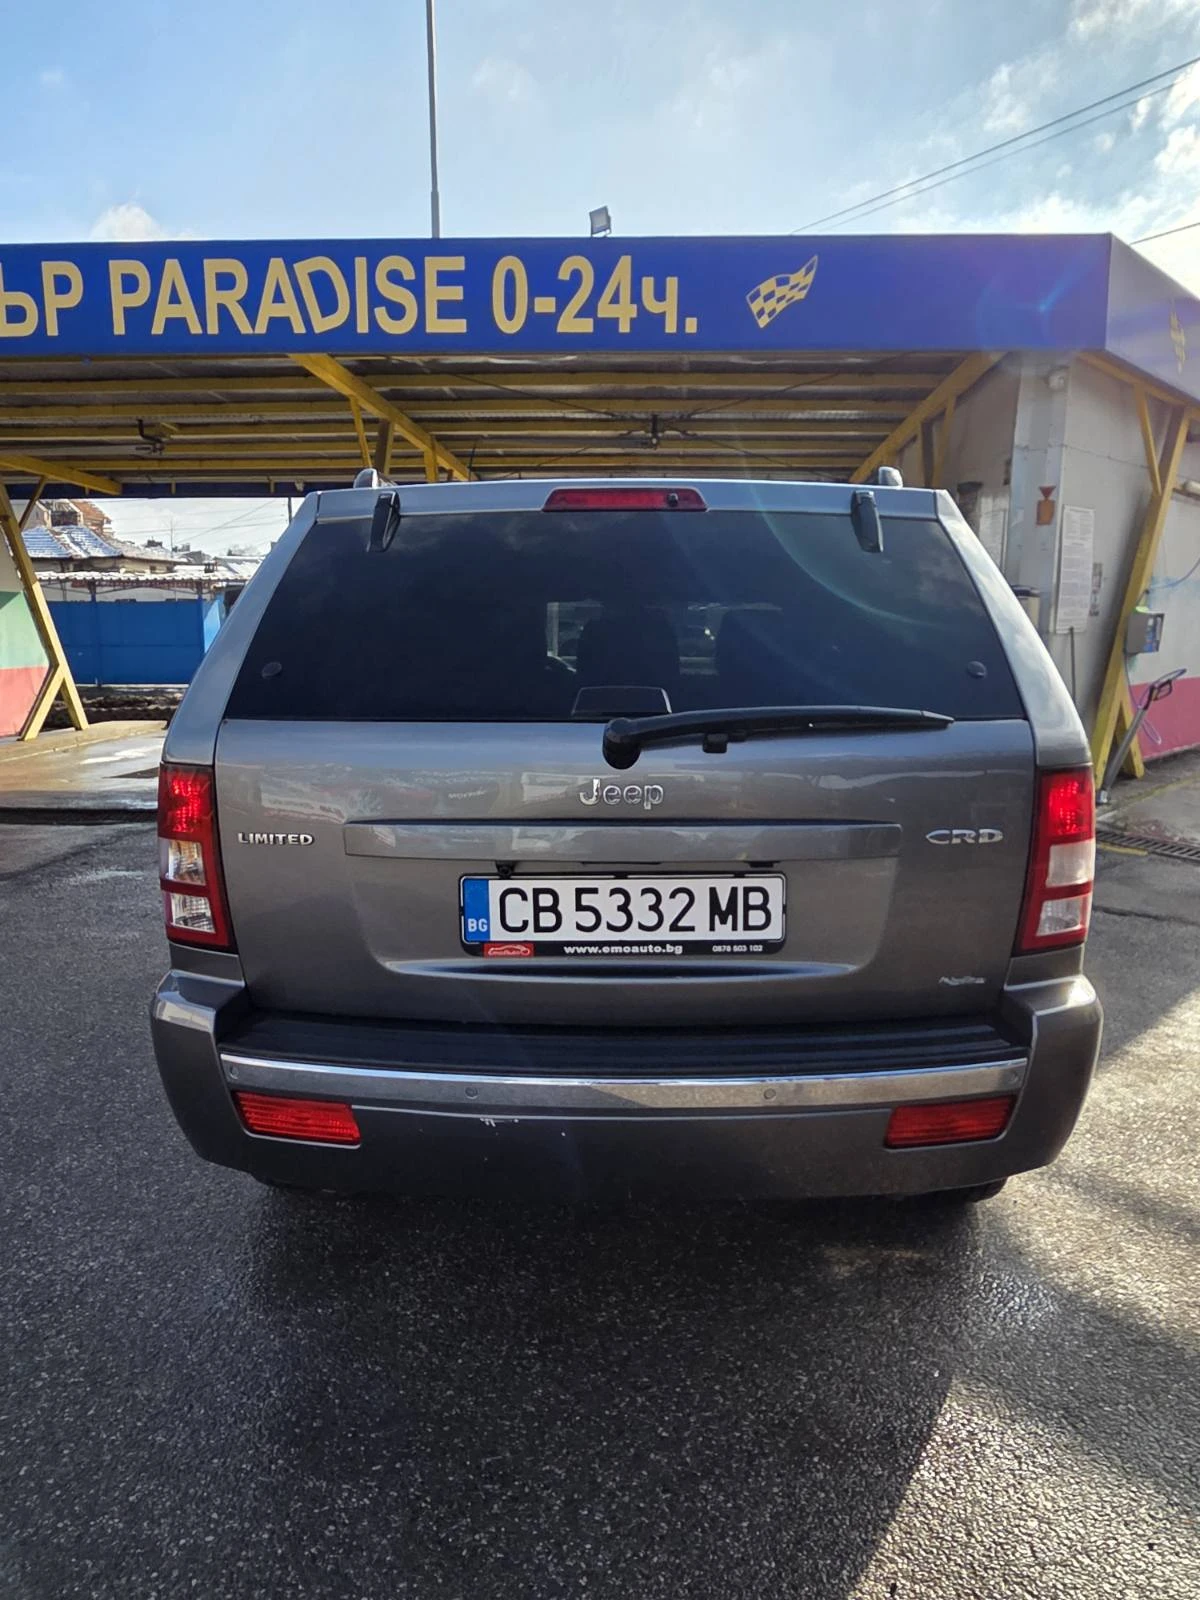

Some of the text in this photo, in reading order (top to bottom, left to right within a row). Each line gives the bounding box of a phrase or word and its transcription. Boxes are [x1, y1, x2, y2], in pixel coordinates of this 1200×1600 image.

[108, 255, 468, 336] PARADISE
[579, 778, 664, 810] Jeep
[237, 832, 313, 846] LIMITED
[926, 828, 1004, 845] CRD
[499, 886, 772, 933] CB 5332 MB
[467, 918, 488, 932] BG
